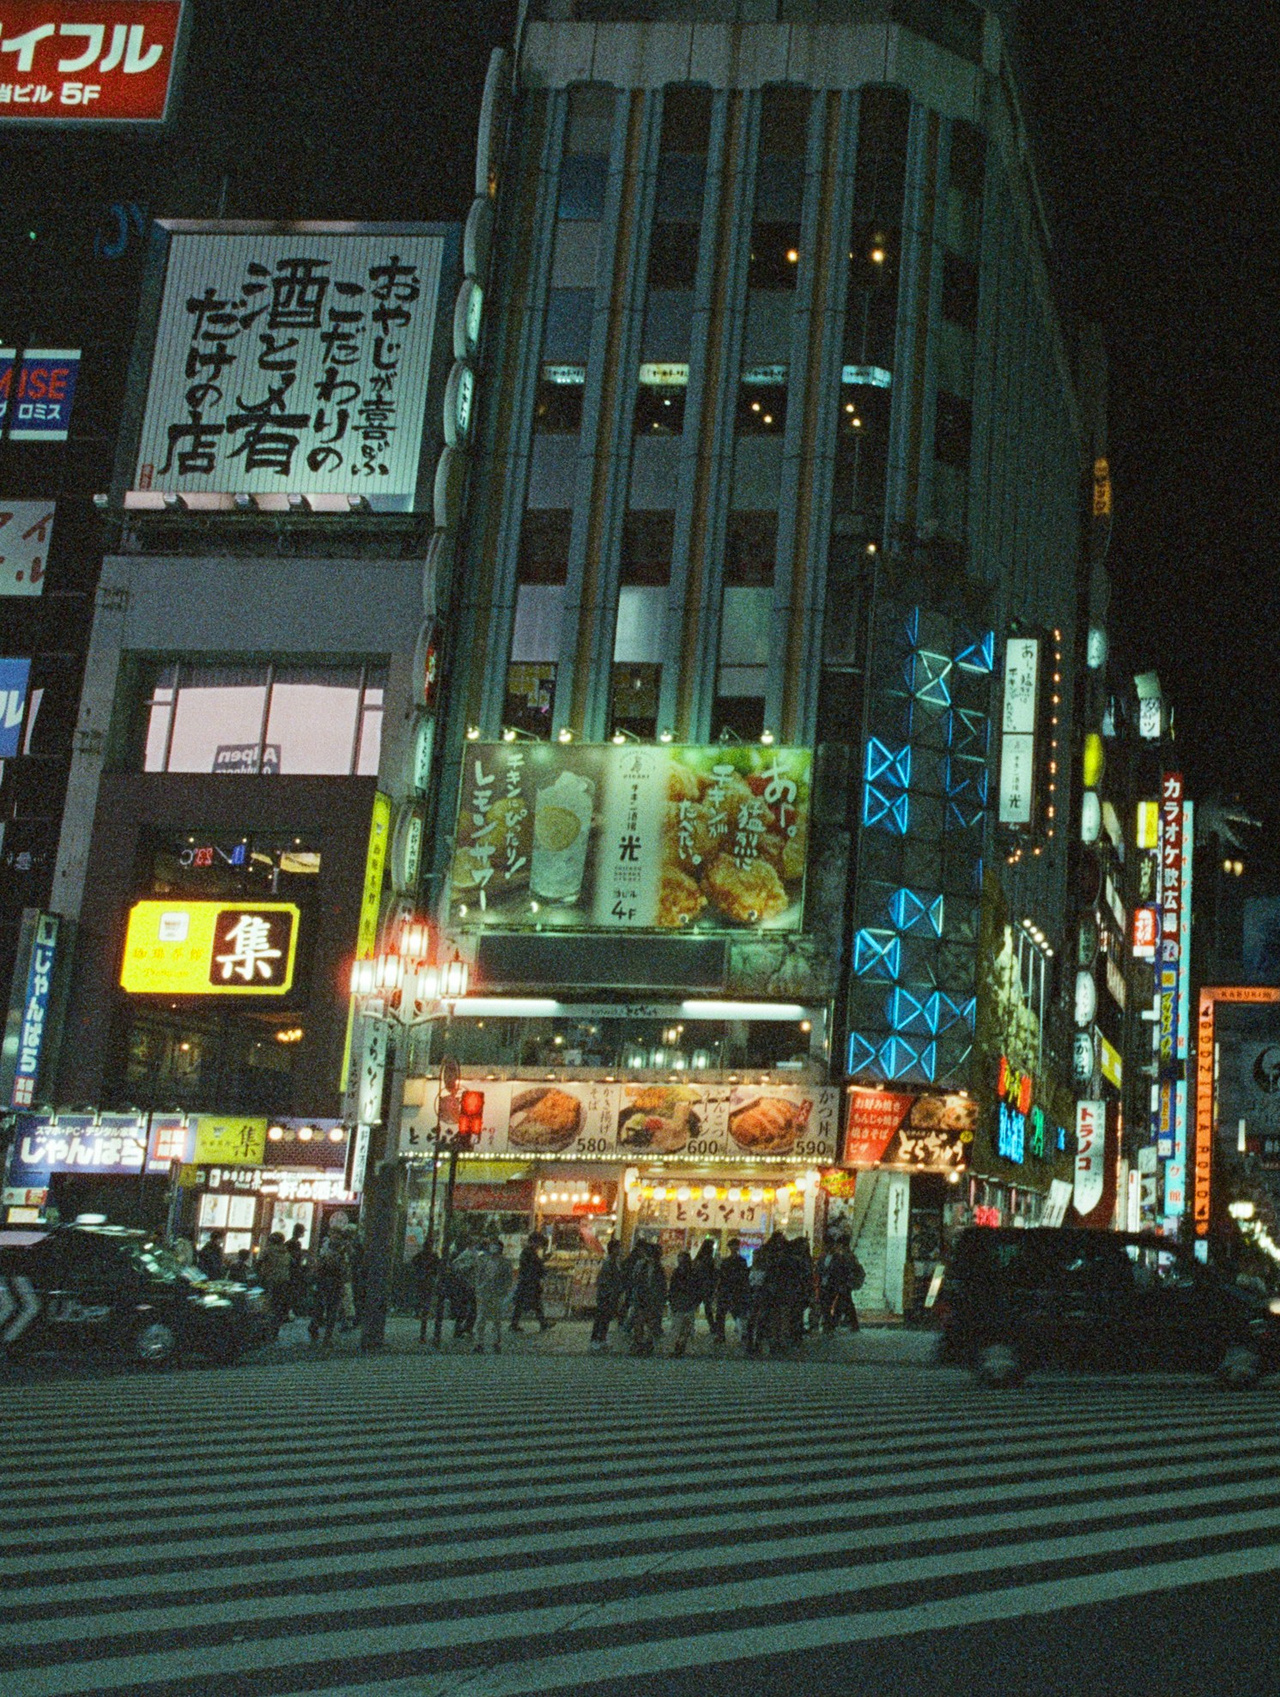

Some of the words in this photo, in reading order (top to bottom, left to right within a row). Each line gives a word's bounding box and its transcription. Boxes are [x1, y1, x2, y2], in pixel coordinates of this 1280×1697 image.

[0, 24, 163, 73] イフル
[60, 82, 101, 104] 5F
[157, 287, 248, 476] だけの店
[306, 280, 366, 474] こだわりの
[468, 760, 498, 911] レモンサワー
[619, 835, 642, 861] 光
[1163, 778, 1181, 932] カラオケ歌広場
[611, 900, 637, 920] 4F
[216, 915, 282, 981] 集
[20, 948, 51, 1073] じゃんぱら
[1197, 1020, 1212, 1132] GODZILLA
[20, 1137, 147, 1165] じゃんぱら
[232, 1125, 261, 1158] 集
[577, 1139, 606, 1152] 580
[688, 1140, 718, 1154] 600
[796, 1141, 826, 1155] 590
[1077, 1107, 1093, 1171] トラノコ
[1195, 1144, 1210, 1200] ROAD
